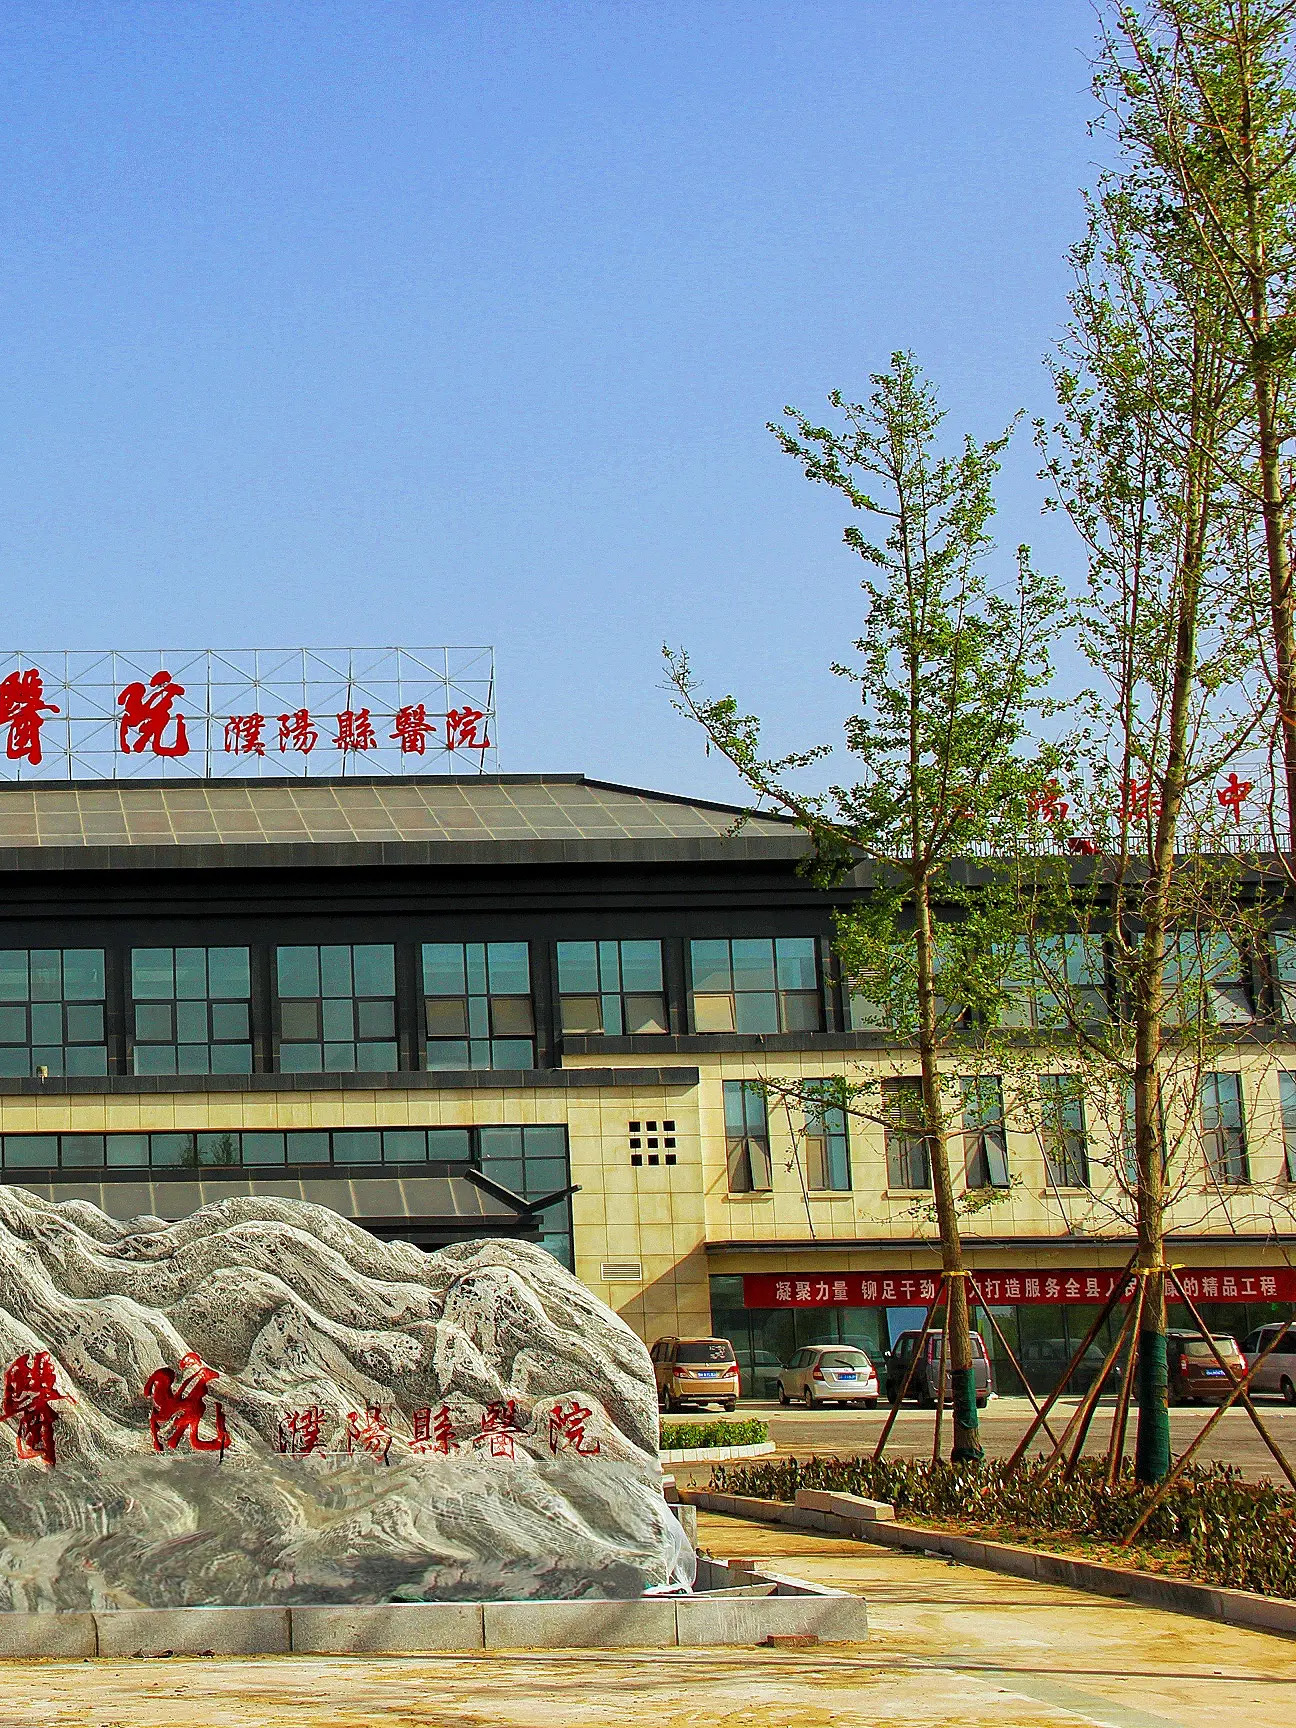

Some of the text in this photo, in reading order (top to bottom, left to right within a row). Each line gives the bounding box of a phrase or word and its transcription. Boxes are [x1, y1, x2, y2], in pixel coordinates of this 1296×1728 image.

[774, 1280, 849, 1301] 凝聚力量
[861, 1279, 936, 1301] 铆足干劲
